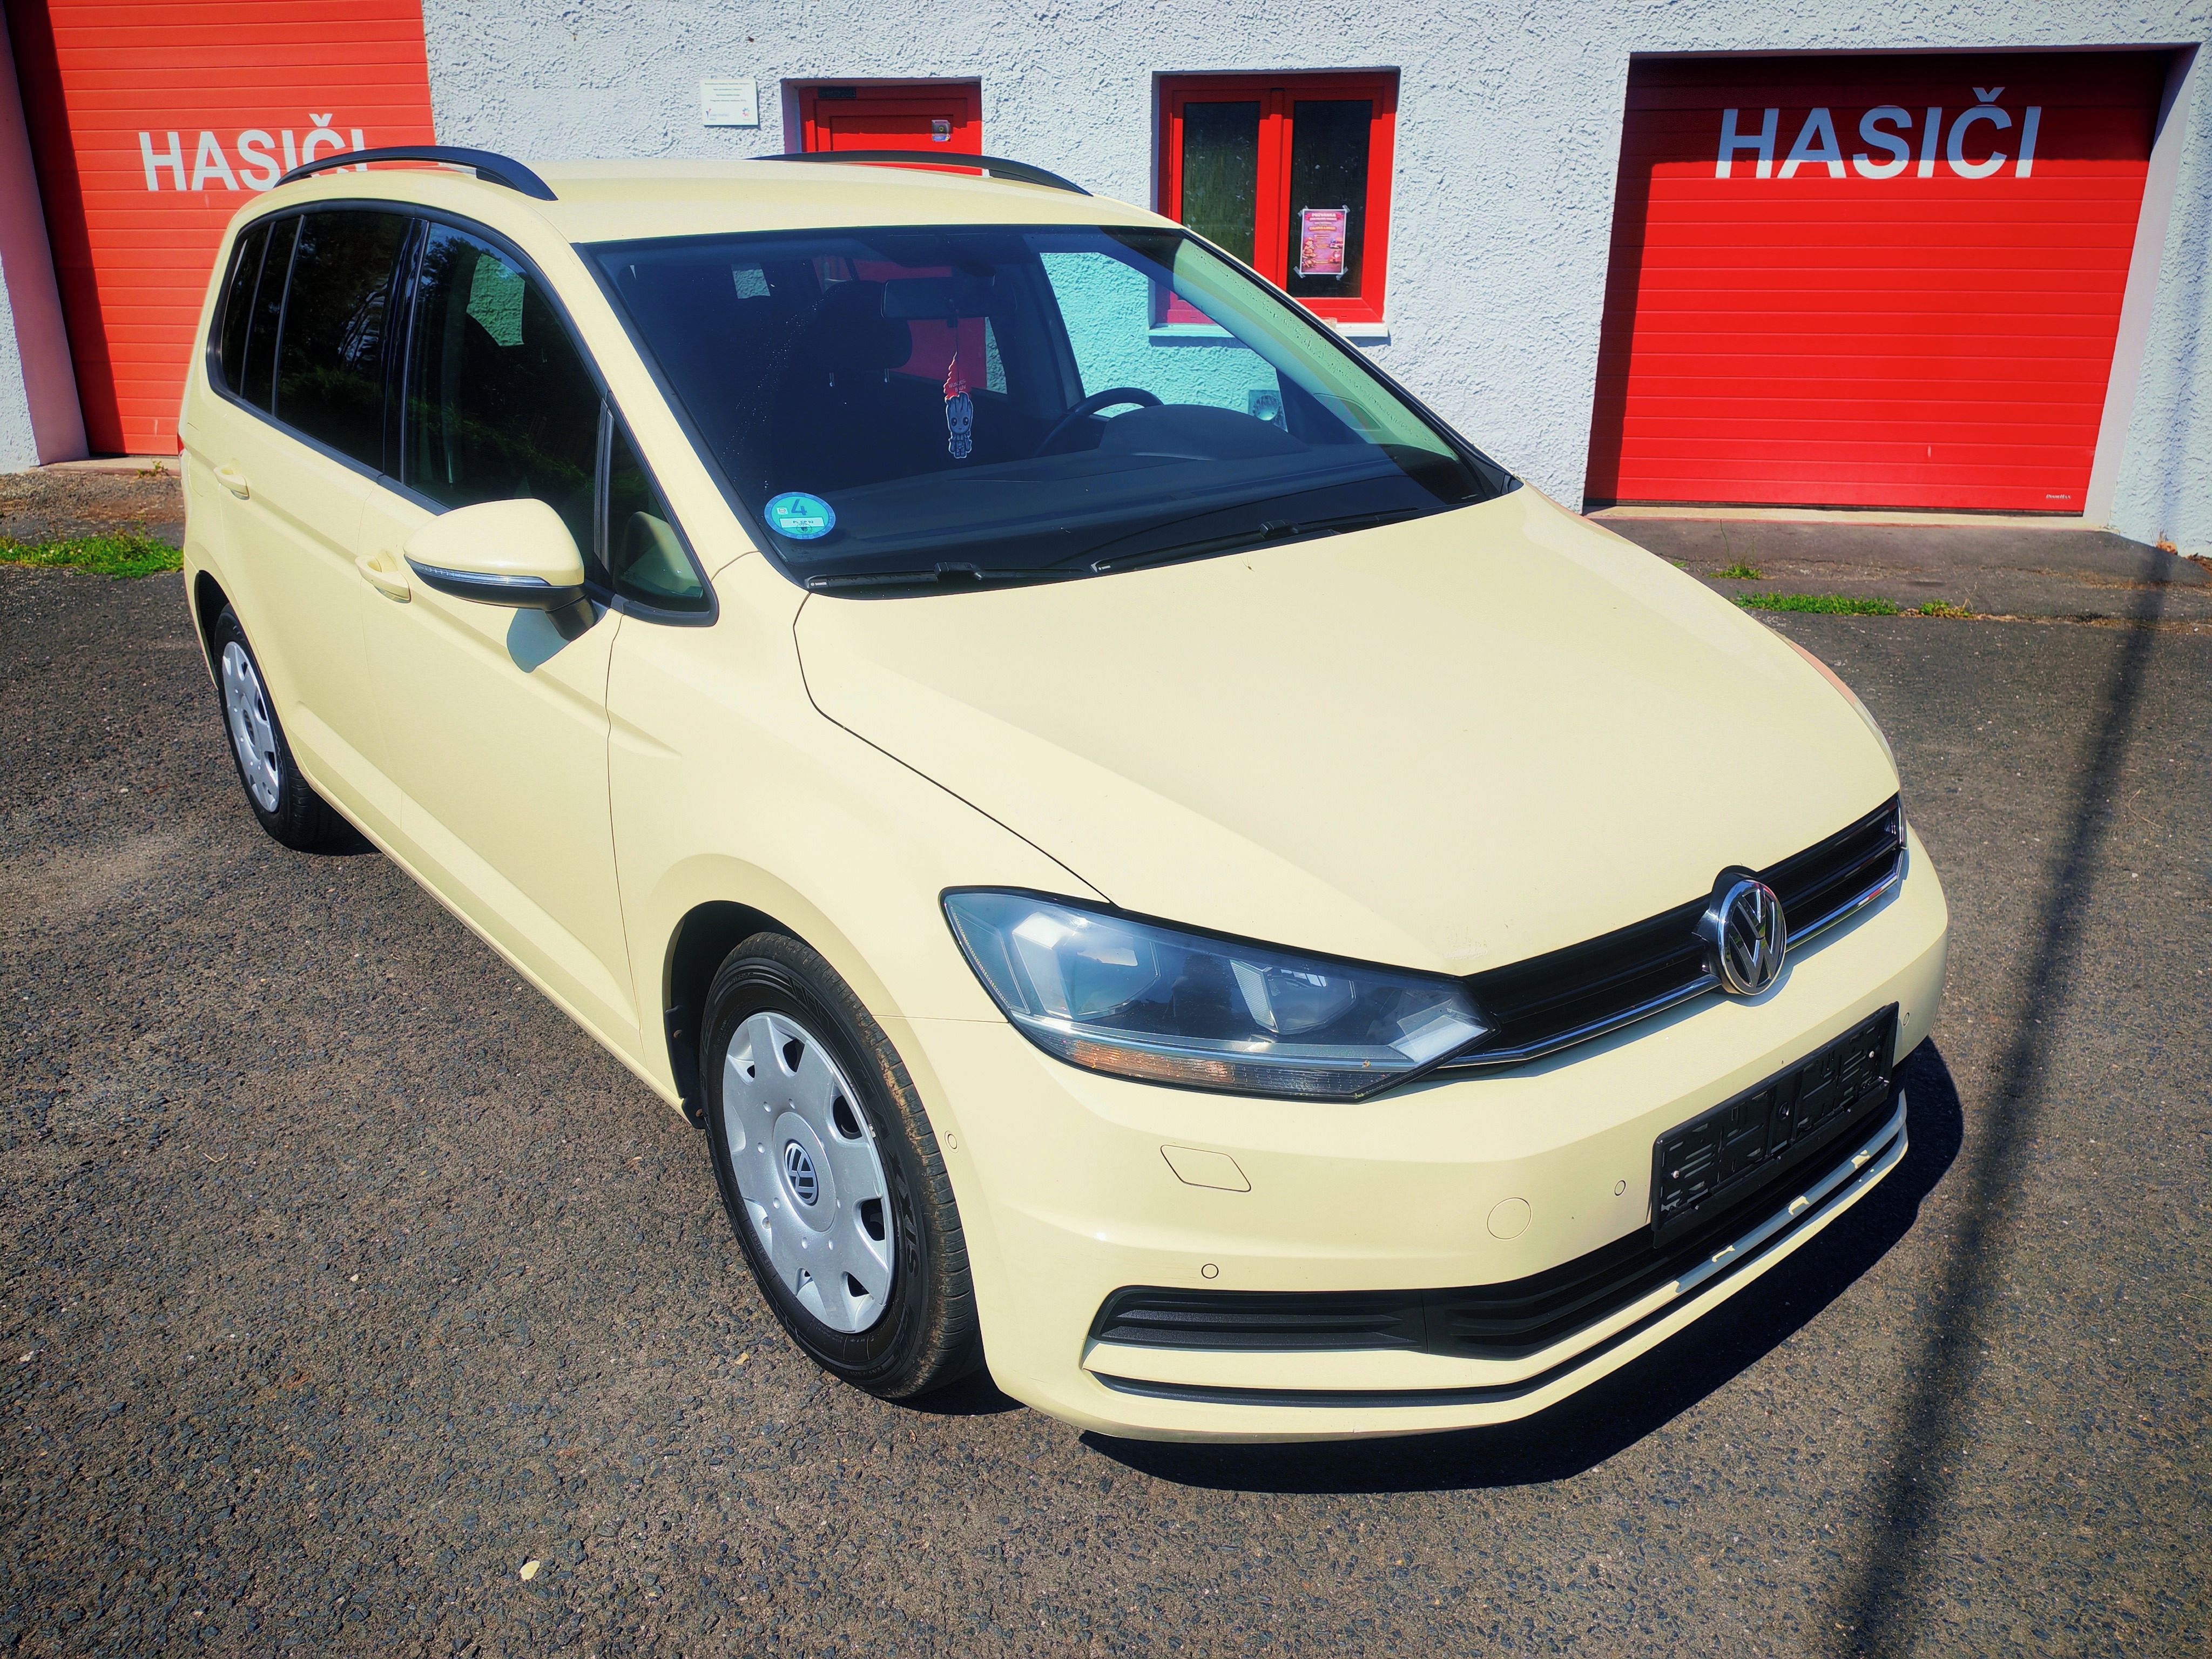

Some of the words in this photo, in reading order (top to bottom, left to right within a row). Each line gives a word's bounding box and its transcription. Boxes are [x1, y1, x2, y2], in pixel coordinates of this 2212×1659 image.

[139, 113, 368, 192] HASIČI
[1715, 87, 2041, 179] HASIČI
[791, 499, 807, 515] 4
[1723, 882, 1783, 992] VW
[854, 1067, 918, 1278] MAXXIS
